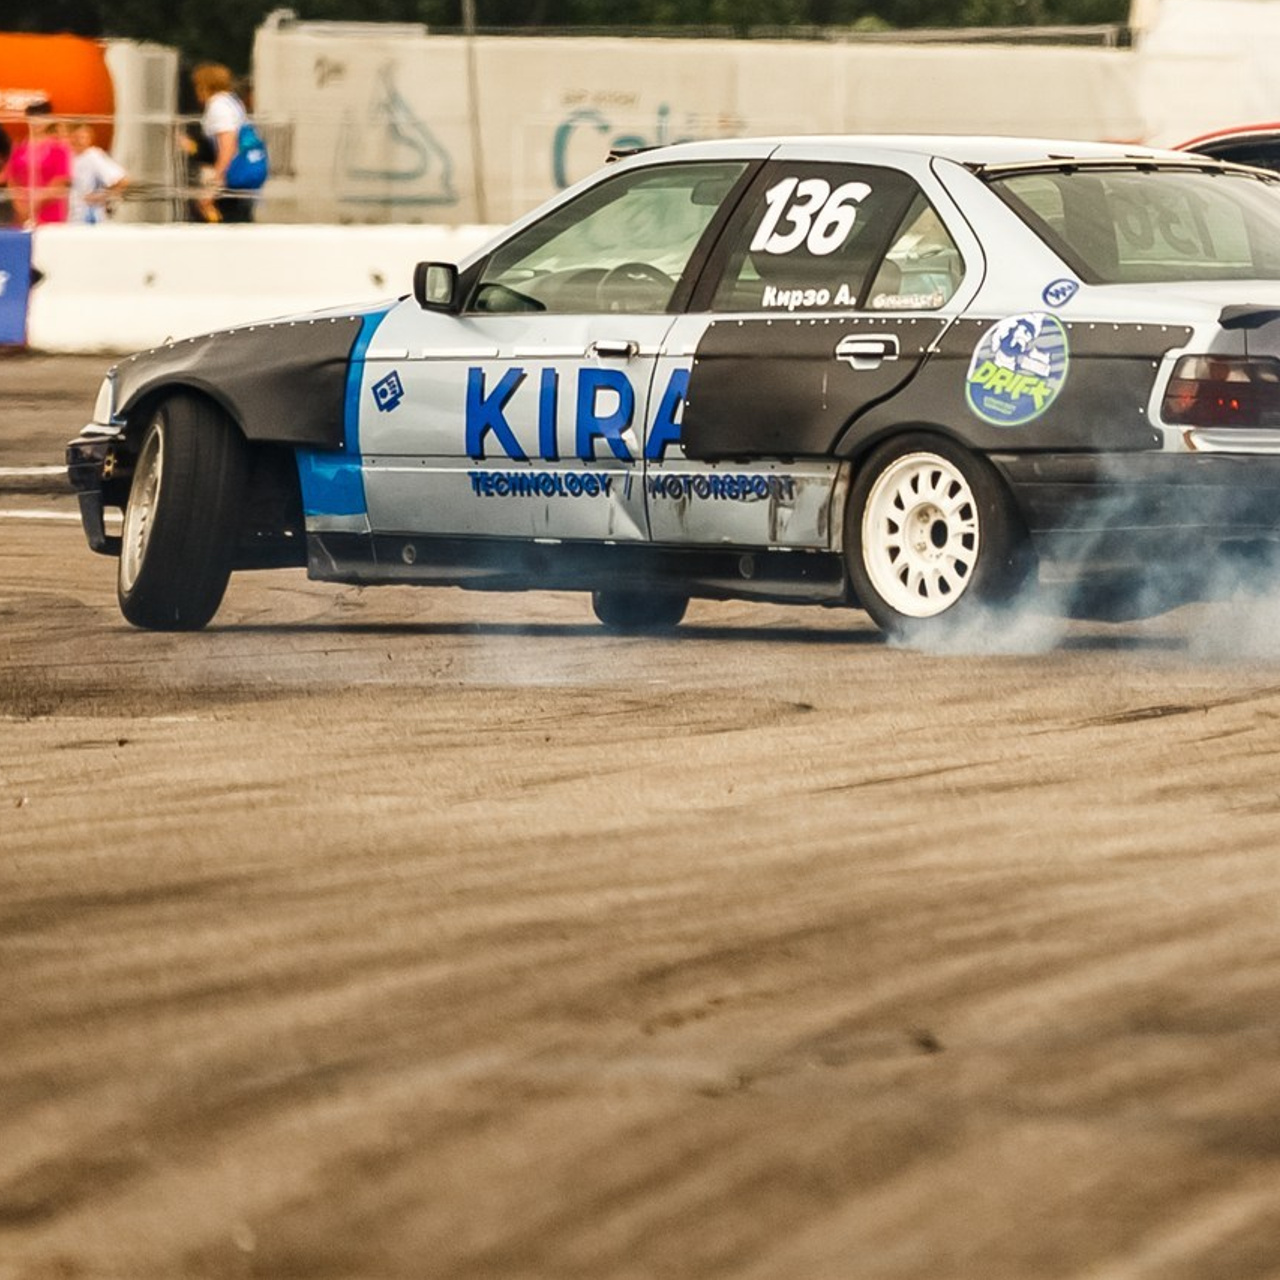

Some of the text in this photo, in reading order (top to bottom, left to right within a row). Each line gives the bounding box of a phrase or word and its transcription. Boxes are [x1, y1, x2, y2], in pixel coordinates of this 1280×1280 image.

[750, 177, 872, 256] 136
[762, 286, 829, 311] Кирзо
[467, 471, 796, 501] TECHNOLOGY MOTORSPORT
